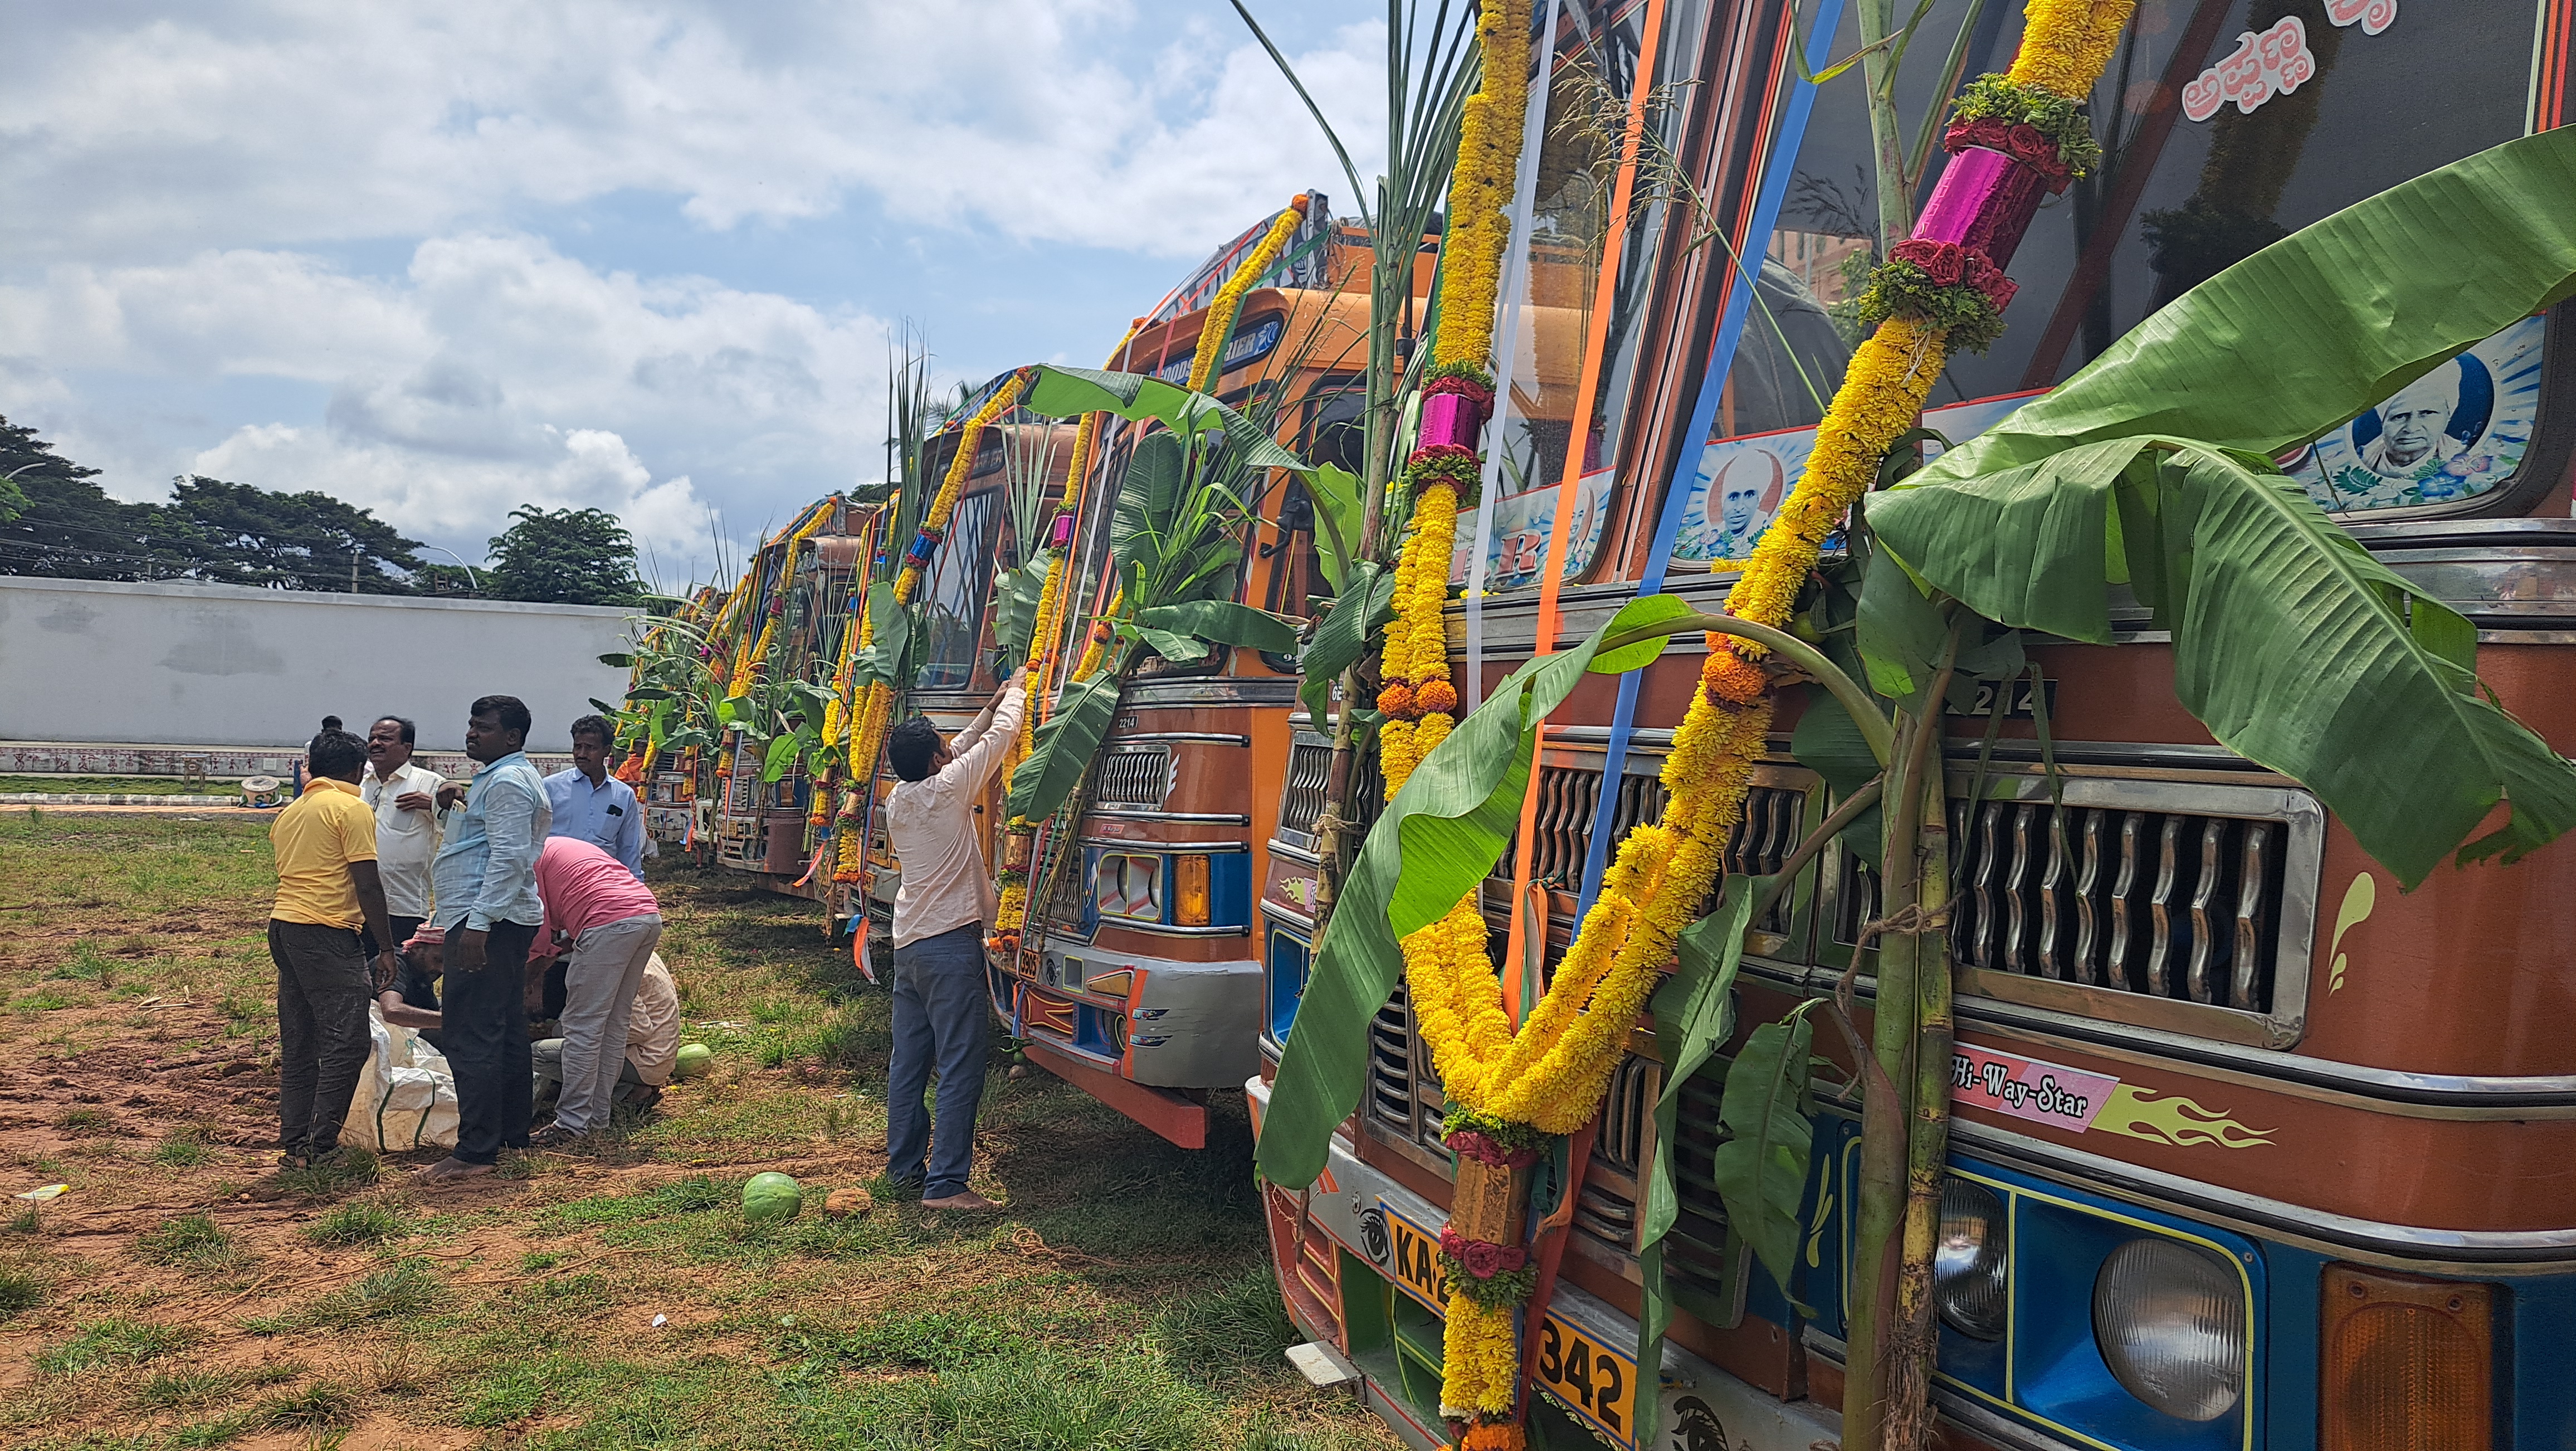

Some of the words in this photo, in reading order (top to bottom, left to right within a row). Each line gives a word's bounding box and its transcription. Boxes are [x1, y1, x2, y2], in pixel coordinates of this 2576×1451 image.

[1118, 717, 1135, 729] 2214
[1951, 1053, 2089, 1118] Hi-Way-Star
[1539, 1316, 1623, 1435] 342
